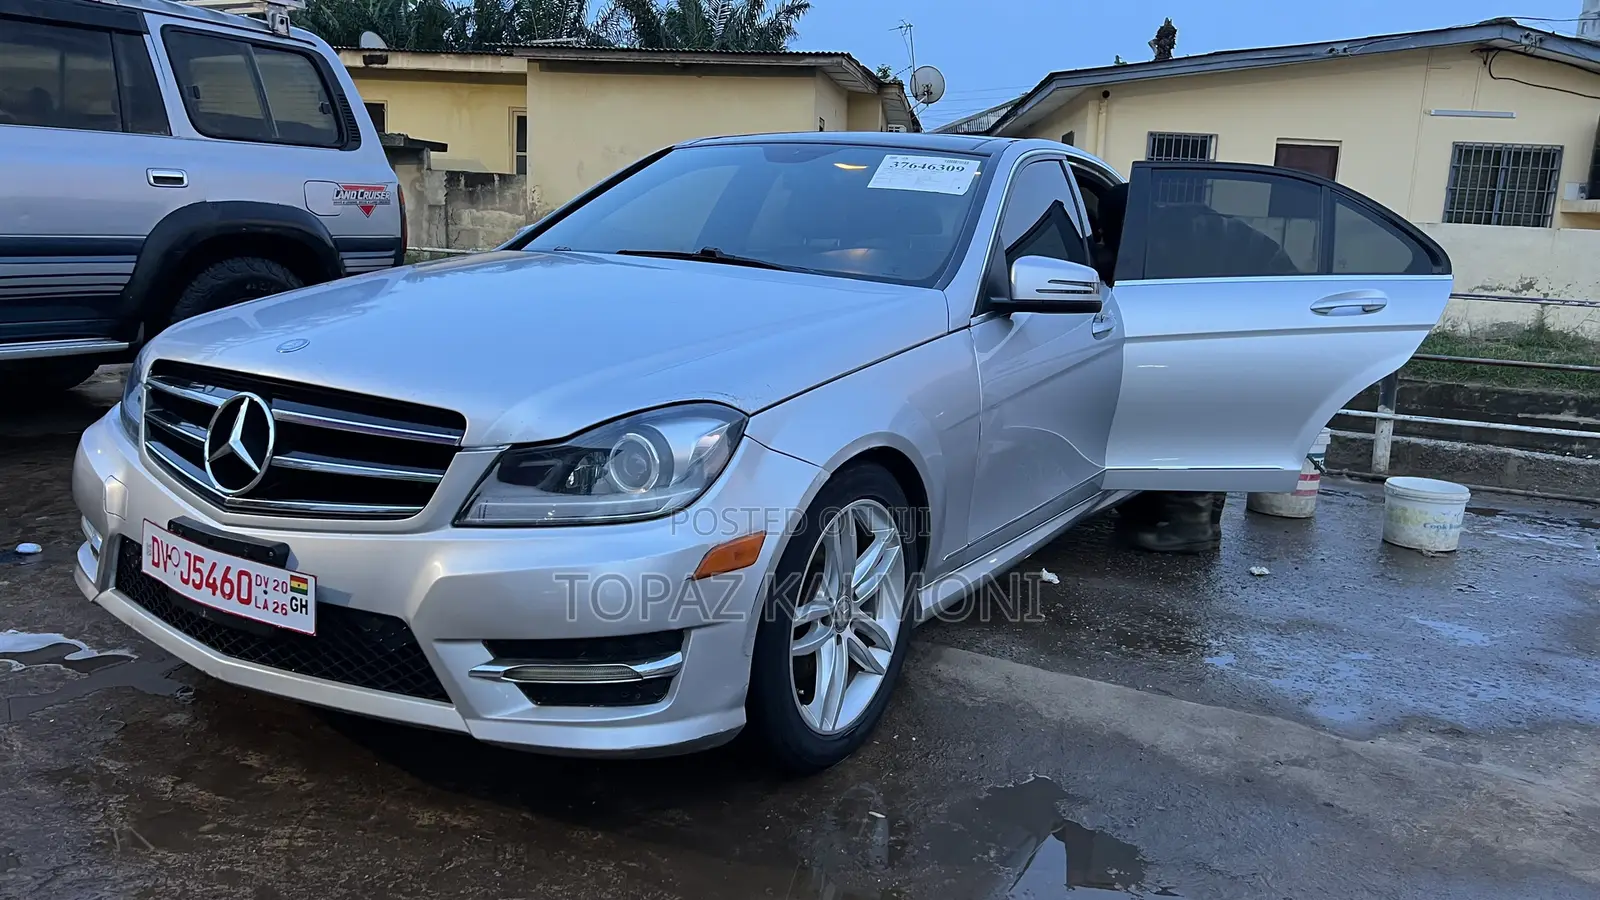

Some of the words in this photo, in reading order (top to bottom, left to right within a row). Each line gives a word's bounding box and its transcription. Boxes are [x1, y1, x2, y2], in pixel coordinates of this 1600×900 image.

[889, 161, 966, 172] 37646309
[333, 188, 358, 200] LAND
[357, 189, 390, 200] CRUISER
[151, 535, 169, 573] DV
[180, 550, 253, 606] J5460
[255, 574, 270, 589] DV
[272, 579, 288, 595] 20
[255, 596, 269, 611] LA
[272, 601, 288, 616] 26
[290, 596, 308, 616] GH
